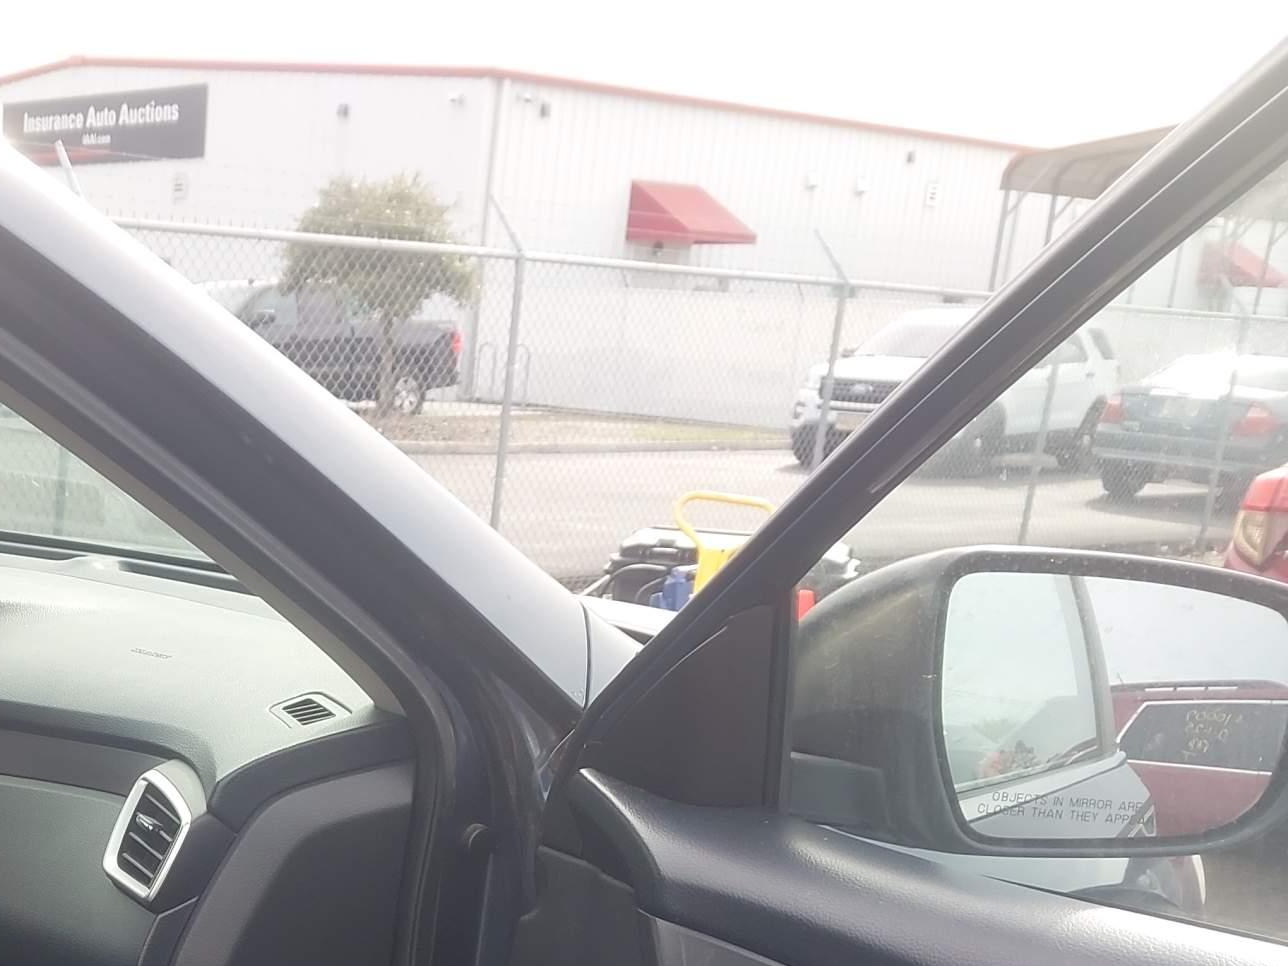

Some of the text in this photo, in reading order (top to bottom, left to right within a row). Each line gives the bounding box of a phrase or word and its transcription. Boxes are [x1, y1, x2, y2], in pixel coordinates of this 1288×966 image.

[24, 101, 179, 132] Insurance Auto Auctions
[992, 791, 1047, 805] OBJECTS
[1053, 797, 1063, 806] IN
[1069, 798, 1112, 811] MIRROR
[977, 803, 1025, 817] CLOSER
[1032, 807, 1062, 820] THAN
[1070, 810, 1098, 823] THEY
